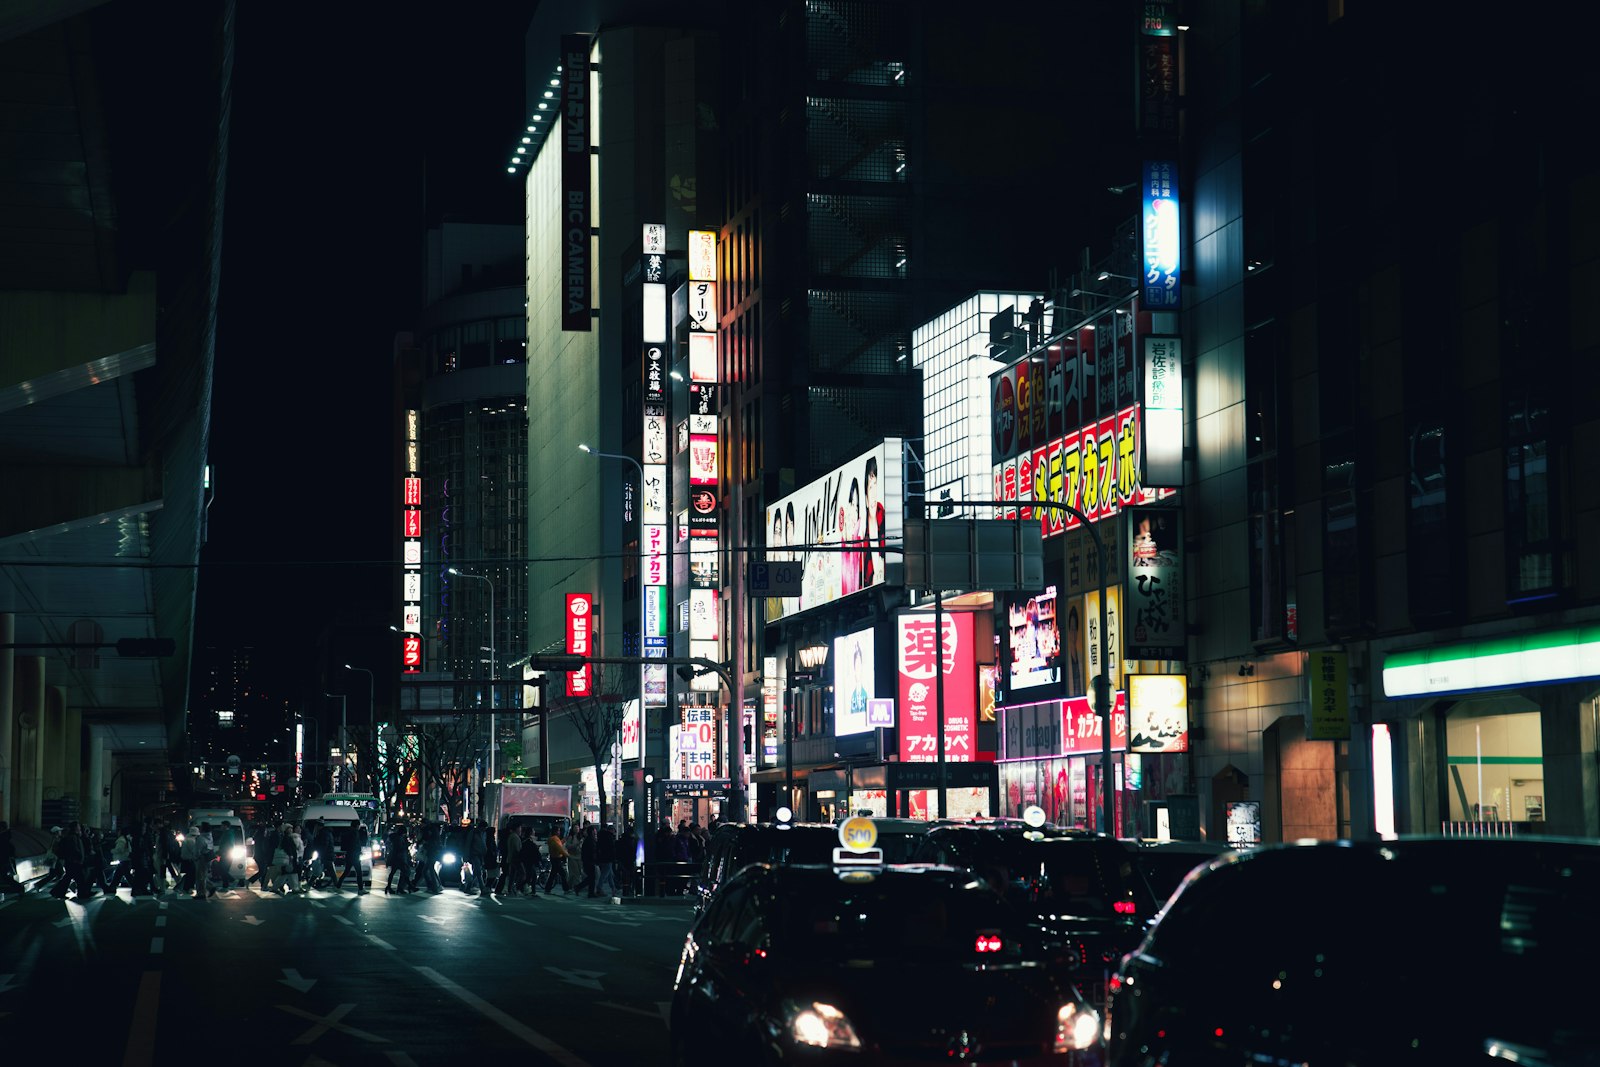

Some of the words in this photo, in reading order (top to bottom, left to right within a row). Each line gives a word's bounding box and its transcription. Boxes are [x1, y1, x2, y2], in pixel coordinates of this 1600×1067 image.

[1145, 18, 1162, 29] PRO
[568, 191, 585, 224] BIC
[568, 228, 585, 316] CAMERA
[697, 284, 709, 323] ダーツ
[1017, 366, 1045, 413] Café
[1048, 350, 1096, 417] ガスト
[1151, 342, 1167, 405] 岩佐診療所
[1018, 405, 1047, 441] レスラン
[650, 528, 661, 583] ジャンカラ
[756, 565, 766, 580] P
[648, 590, 656, 633] FamilyMart
[573, 618, 587, 692] ビックメラ
[904, 620, 956, 674] 薬
[687, 710, 711, 722] 伝串
[949, 717, 962, 725] DRUGS
[1077, 713, 1112, 739] カラオ
[906, 734, 969, 752] アカカベ
[847, 828, 872, 842] 500
